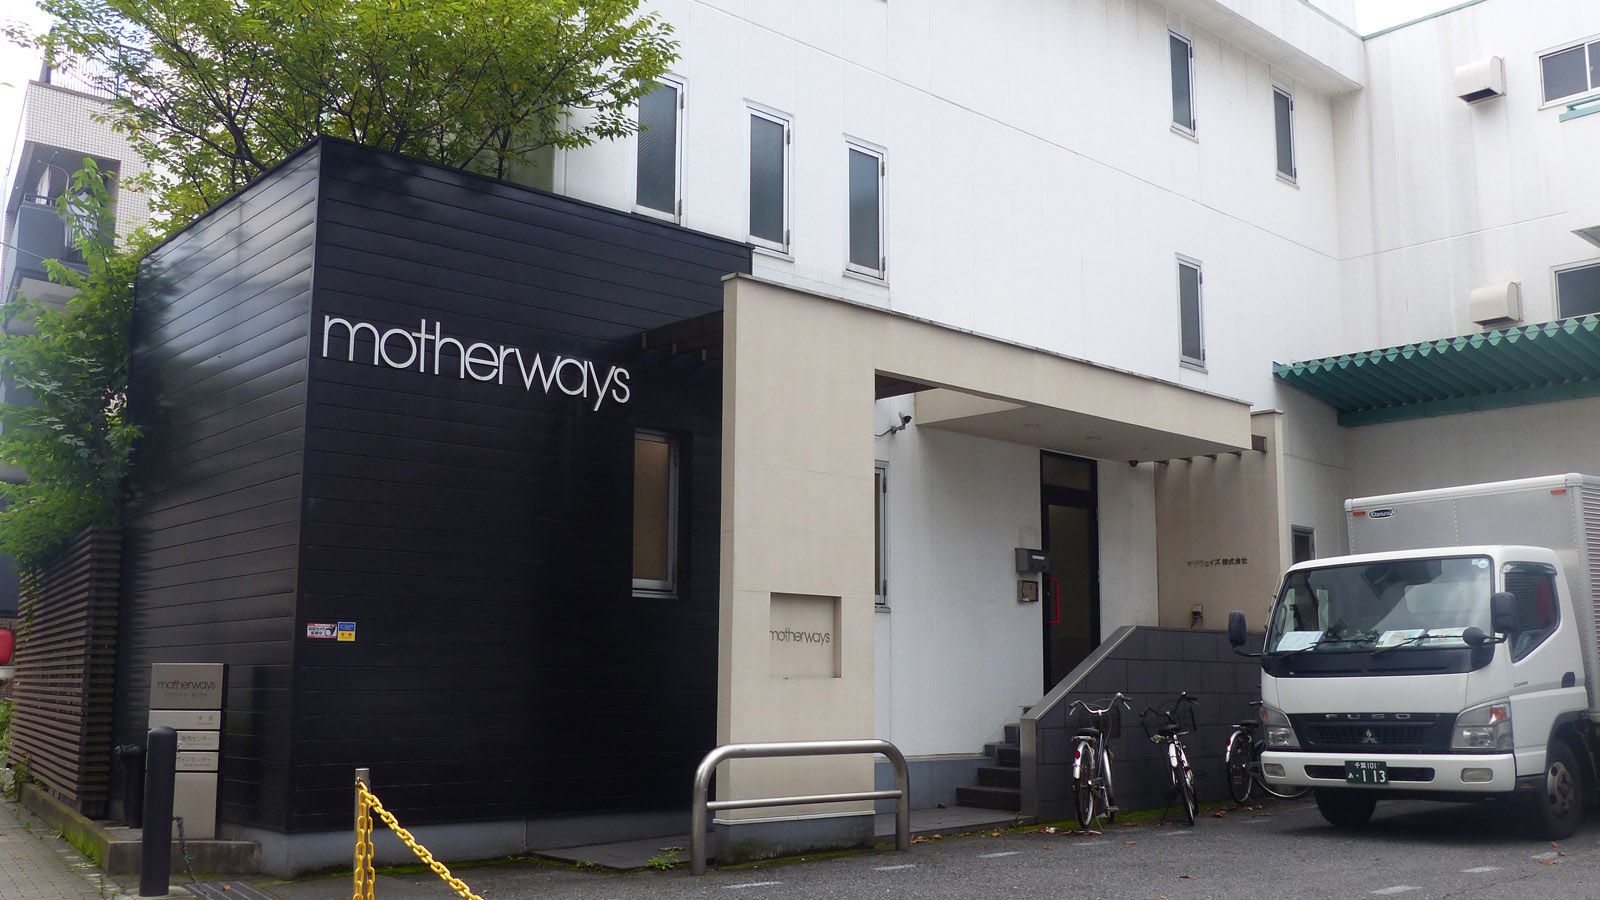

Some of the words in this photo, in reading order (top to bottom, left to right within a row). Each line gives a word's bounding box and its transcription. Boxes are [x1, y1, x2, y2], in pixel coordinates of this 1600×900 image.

[322, 314, 631, 412] motherways
[769, 627, 831, 647] motherways
[157, 680, 216, 692] motherways
